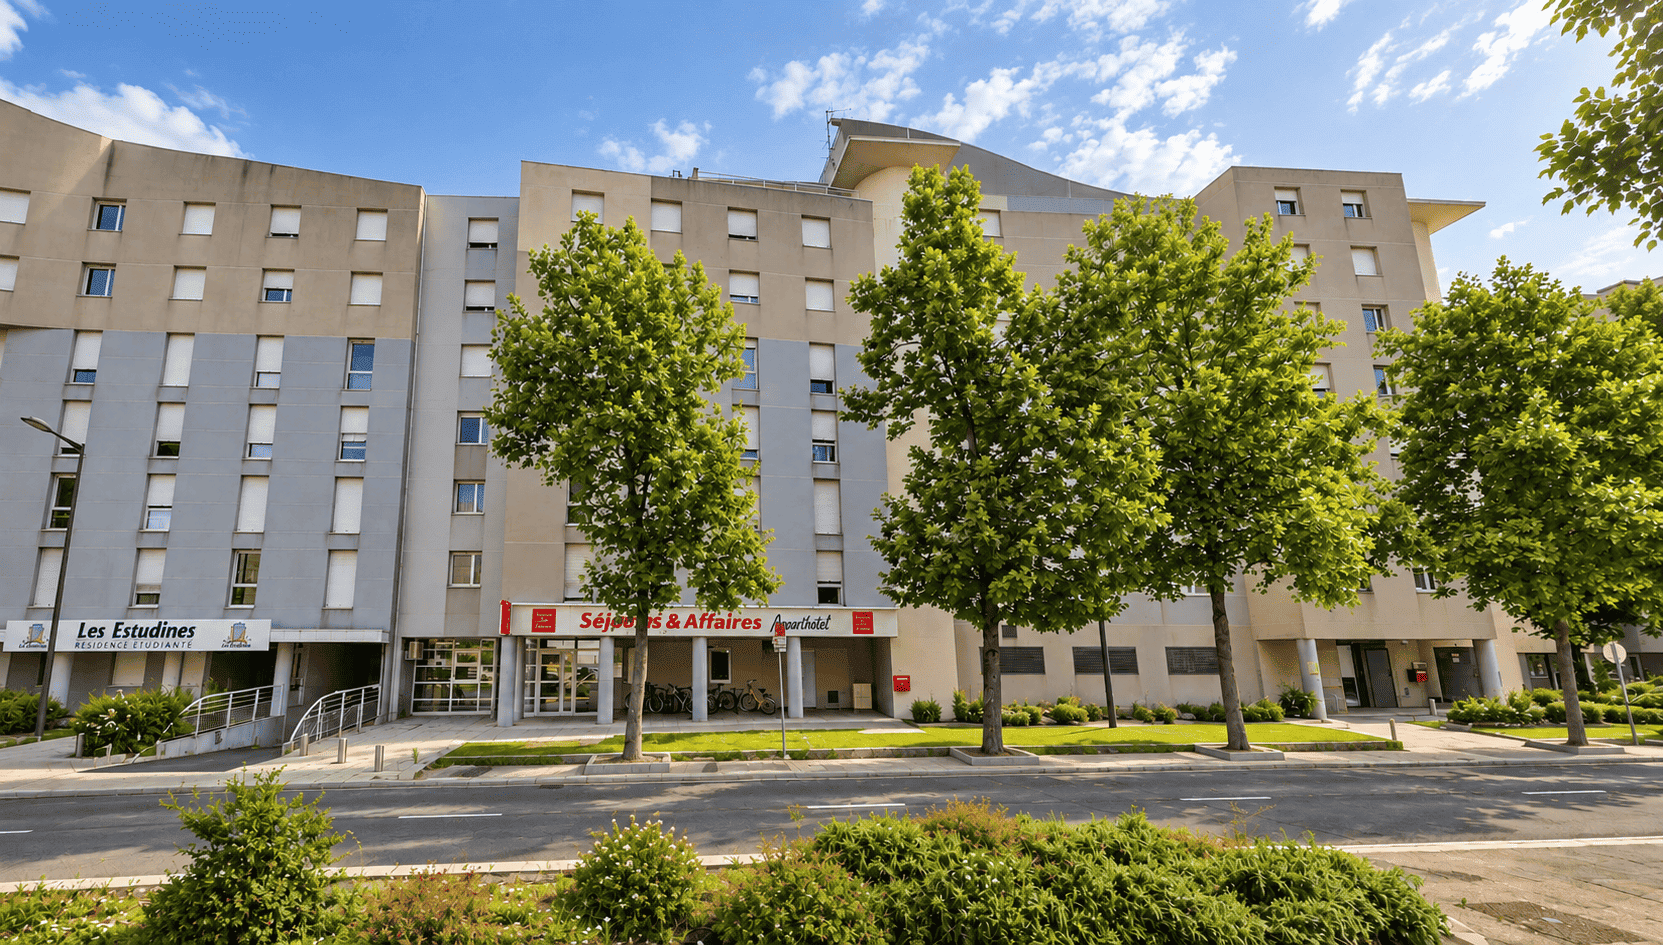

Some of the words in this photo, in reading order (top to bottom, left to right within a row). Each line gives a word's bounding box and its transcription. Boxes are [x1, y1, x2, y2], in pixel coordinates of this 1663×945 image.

[77, 621, 106, 639] Les
[112, 620, 197, 639] Estudines
[666, 613, 681, 629] &
[684, 612, 762, 630] Affaires
